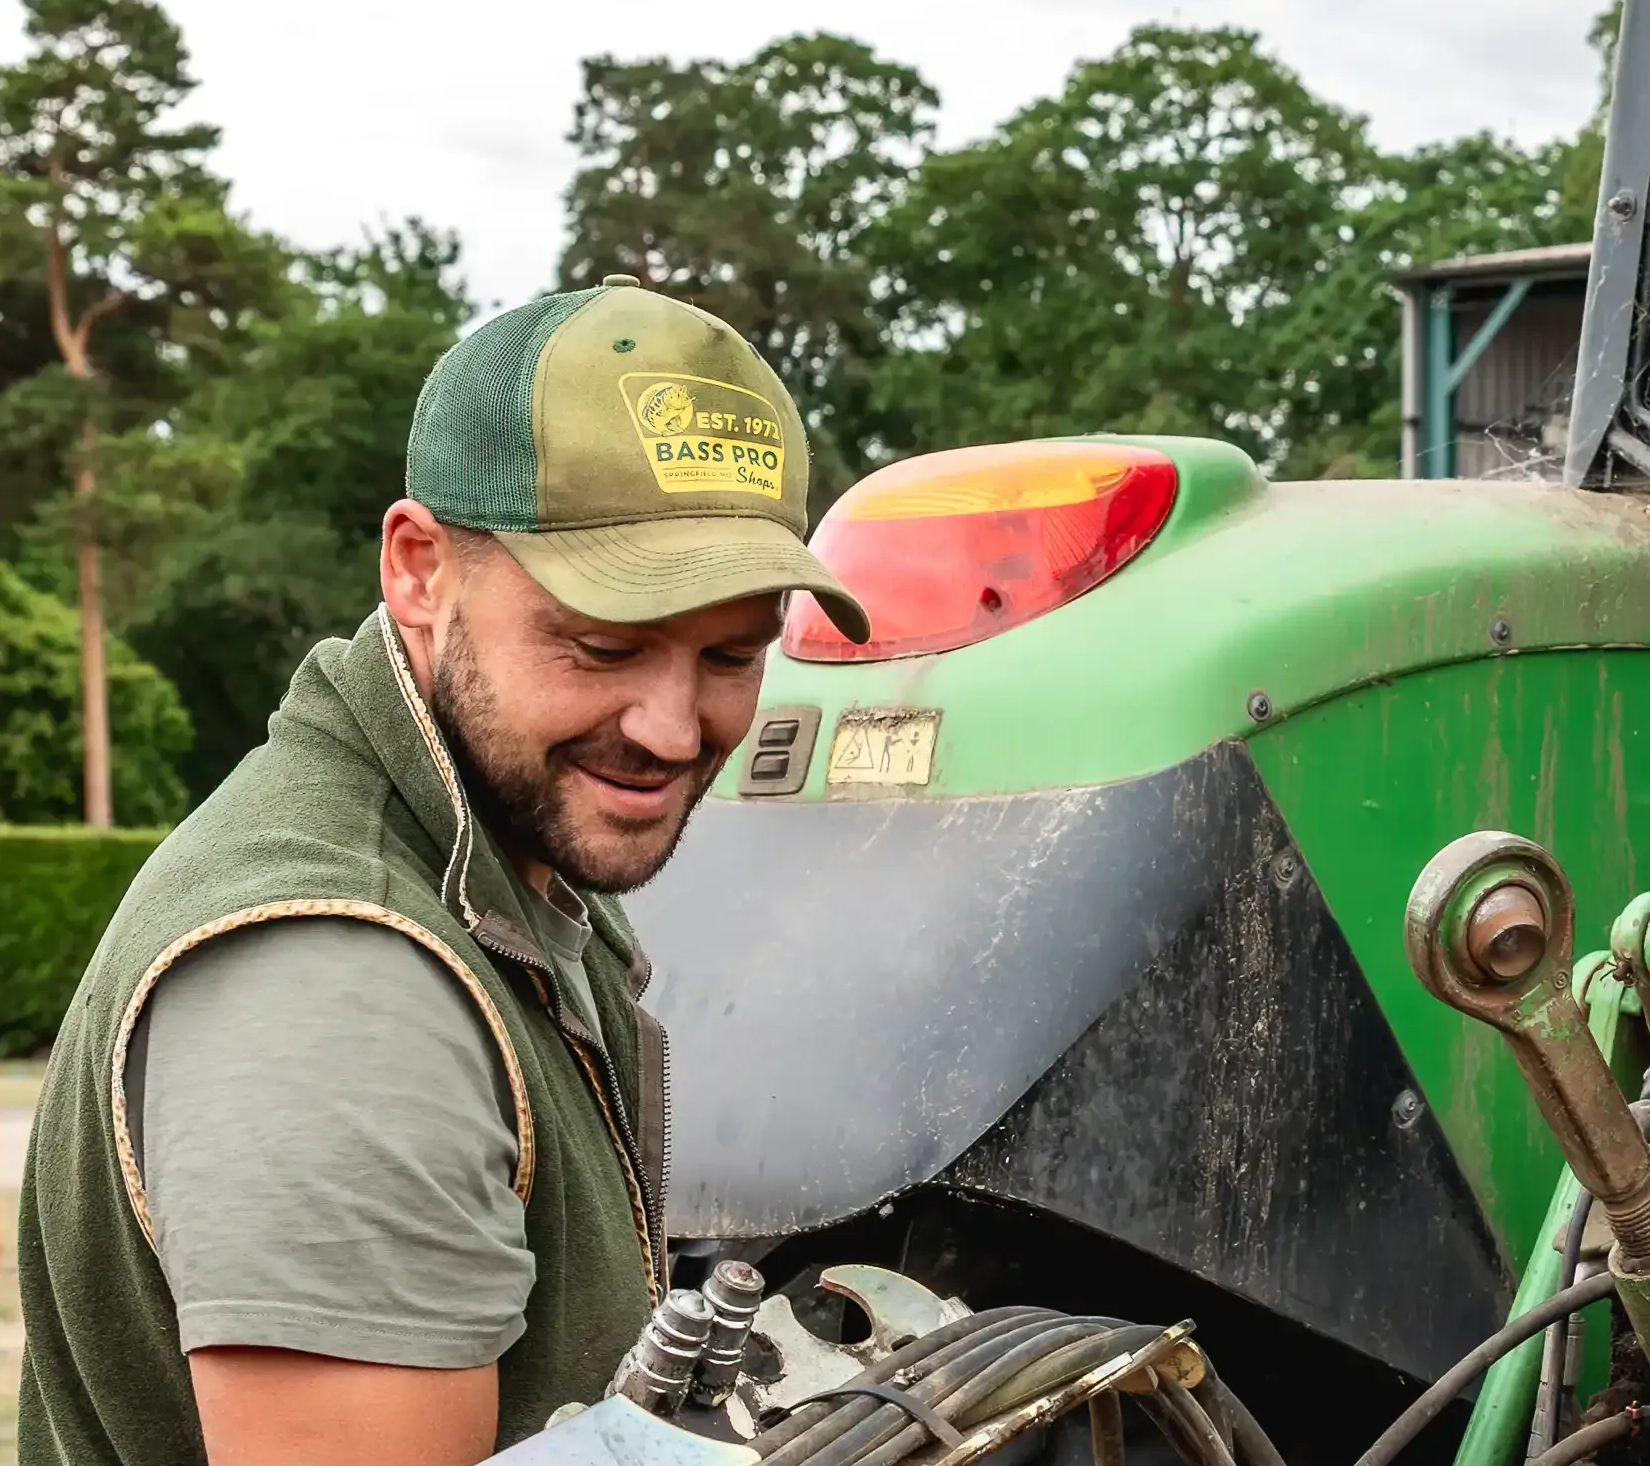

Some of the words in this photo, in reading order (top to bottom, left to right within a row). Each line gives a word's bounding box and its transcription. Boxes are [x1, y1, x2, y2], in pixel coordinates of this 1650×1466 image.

[696, 412, 739, 432] EST.
[744, 416, 781, 440] 1972
[655, 440, 725, 462] BASS
[732, 445, 778, 470] PRO
[736, 466, 774, 491] Shops
